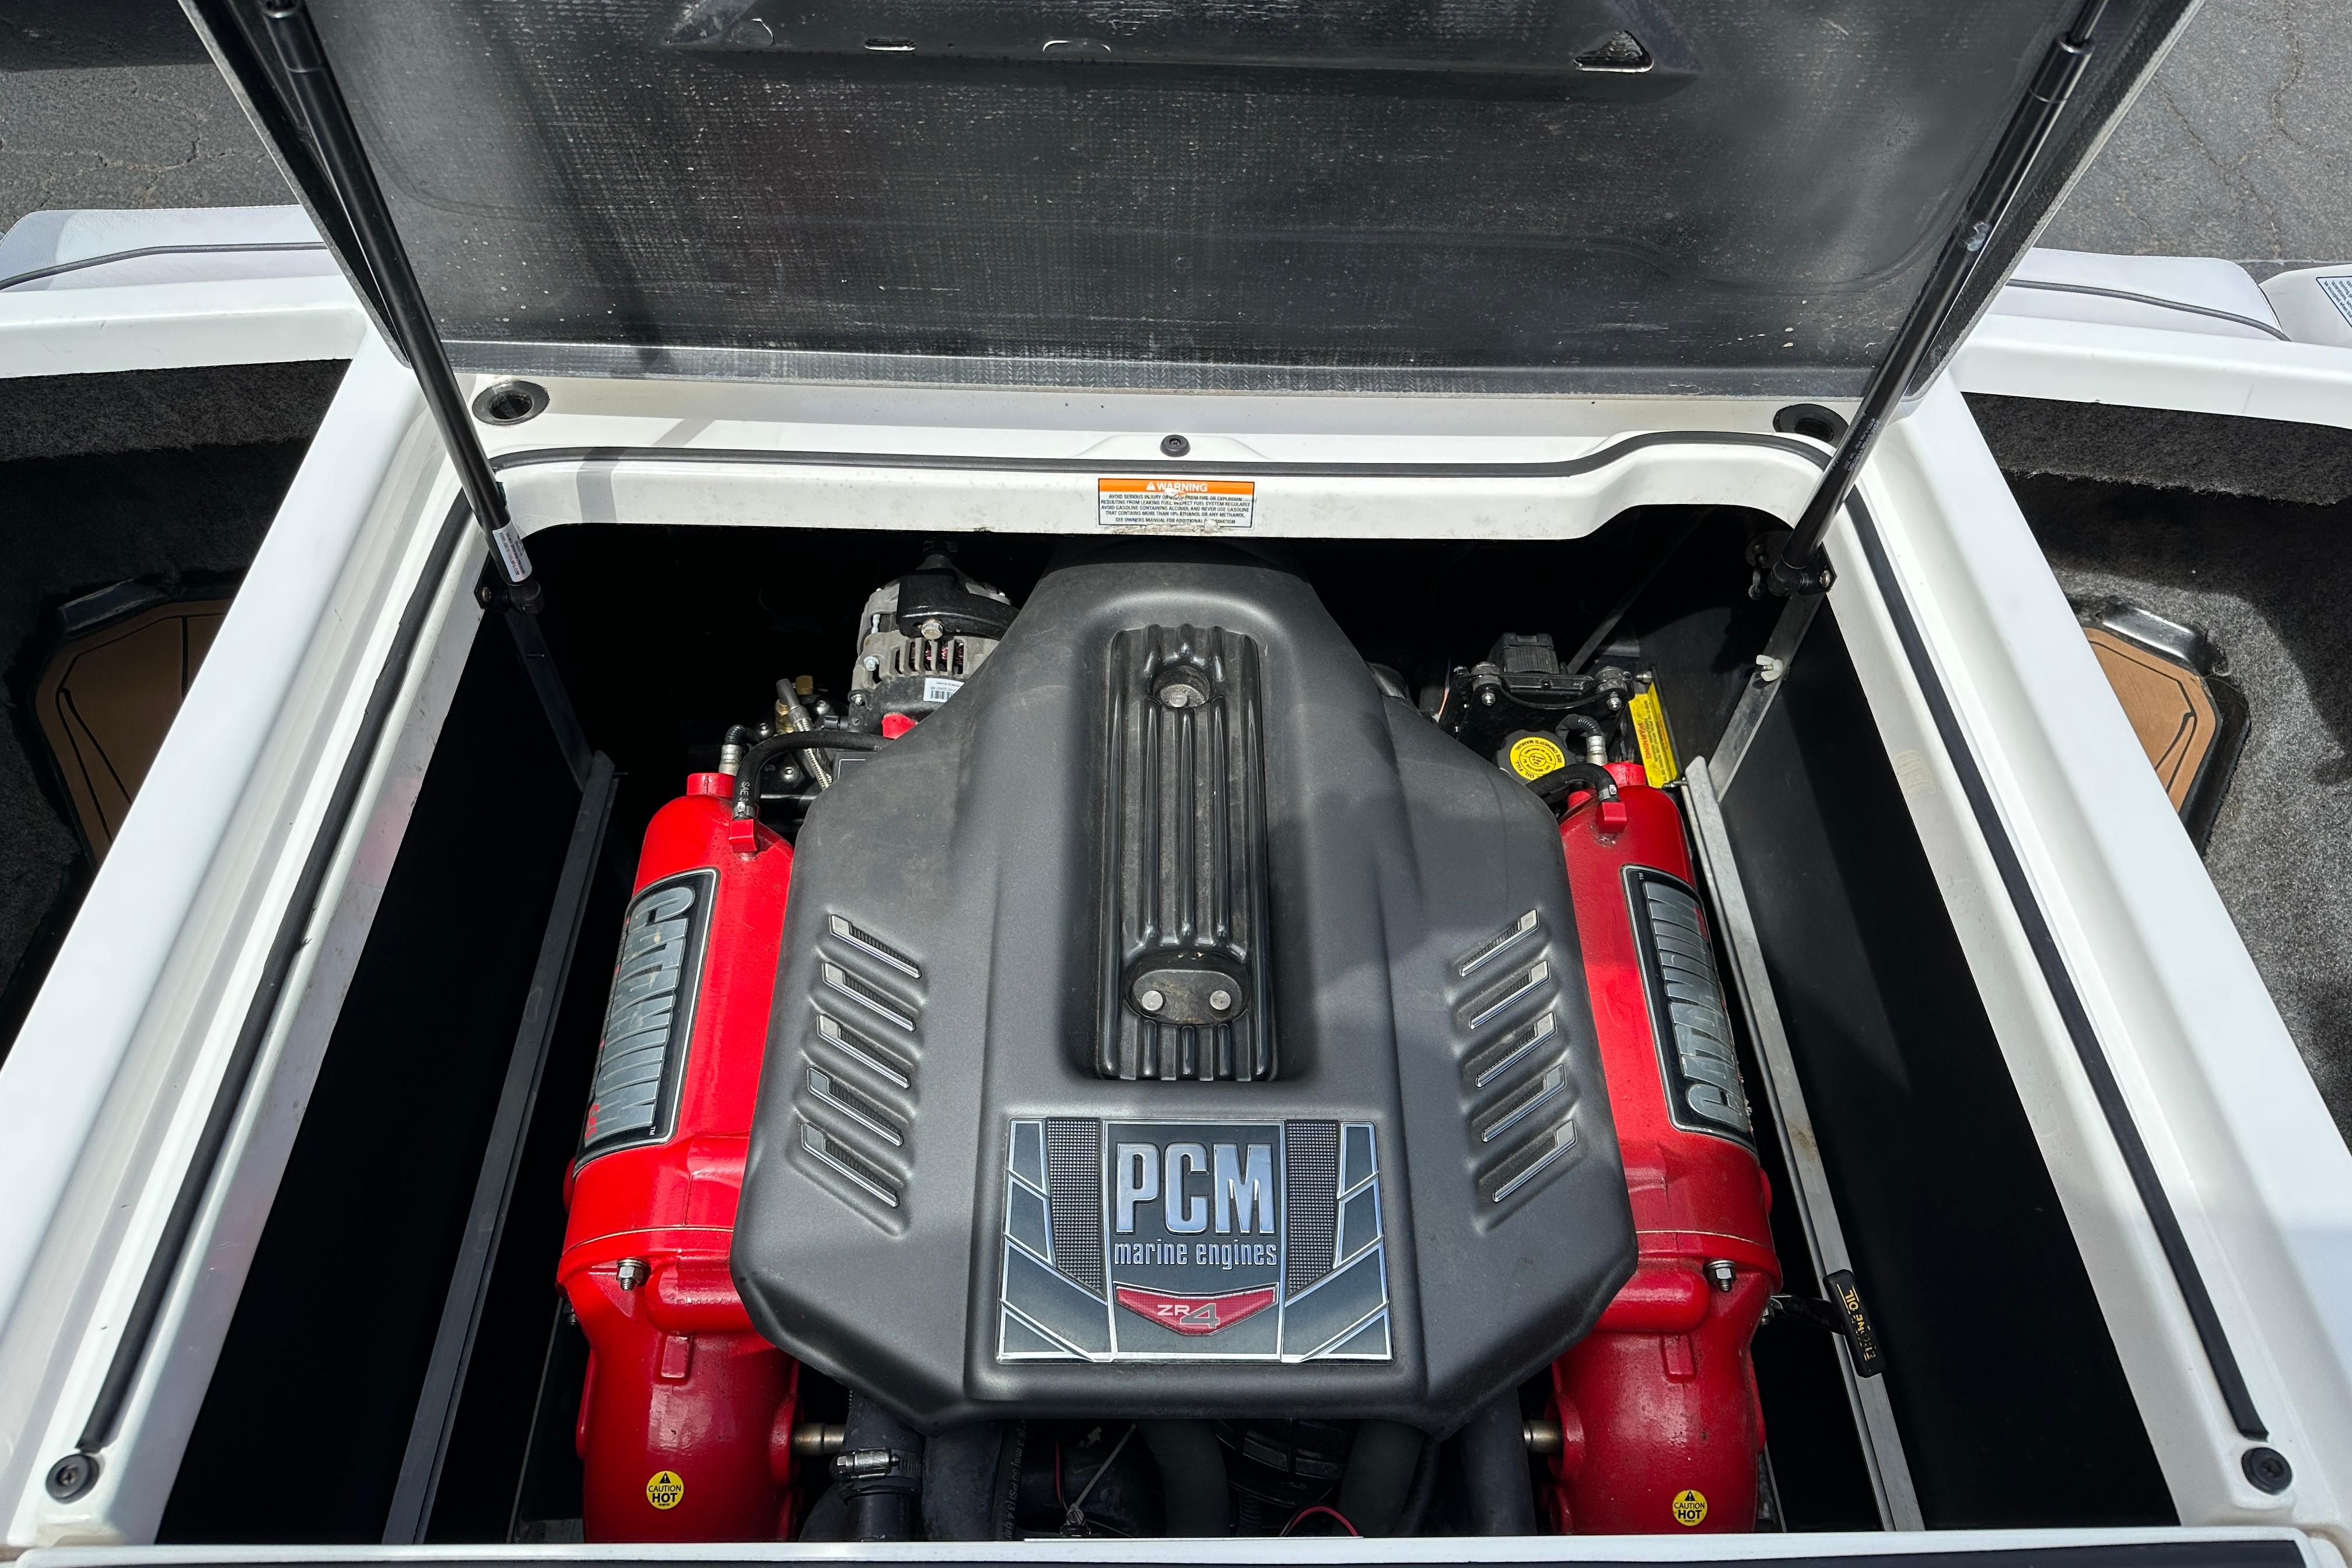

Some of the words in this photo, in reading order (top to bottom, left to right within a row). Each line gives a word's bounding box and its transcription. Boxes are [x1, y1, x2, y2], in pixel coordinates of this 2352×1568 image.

[1157, 482, 1208, 492] WARNING
[1514, 740, 1534, 751] MANUAL
[1638, 722, 1652, 760] WARNING
[1514, 760, 1524, 772] FILL
[1524, 771, 1535, 779] OIL
[740, 781, 750, 796] SAE
[1115, 1142, 1276, 1236] PCM
[1114, 1238, 1188, 1265] marine
[1195, 1239, 1278, 1270] engines
[1845, 1289, 1859, 1311] OIL
[1012, 1468, 1021, 1480] 50
[1009, 1480, 1019, 1501] PSI
[652, 1493, 677, 1503] HOT
[1678, 1510, 1702, 1520] HOT
